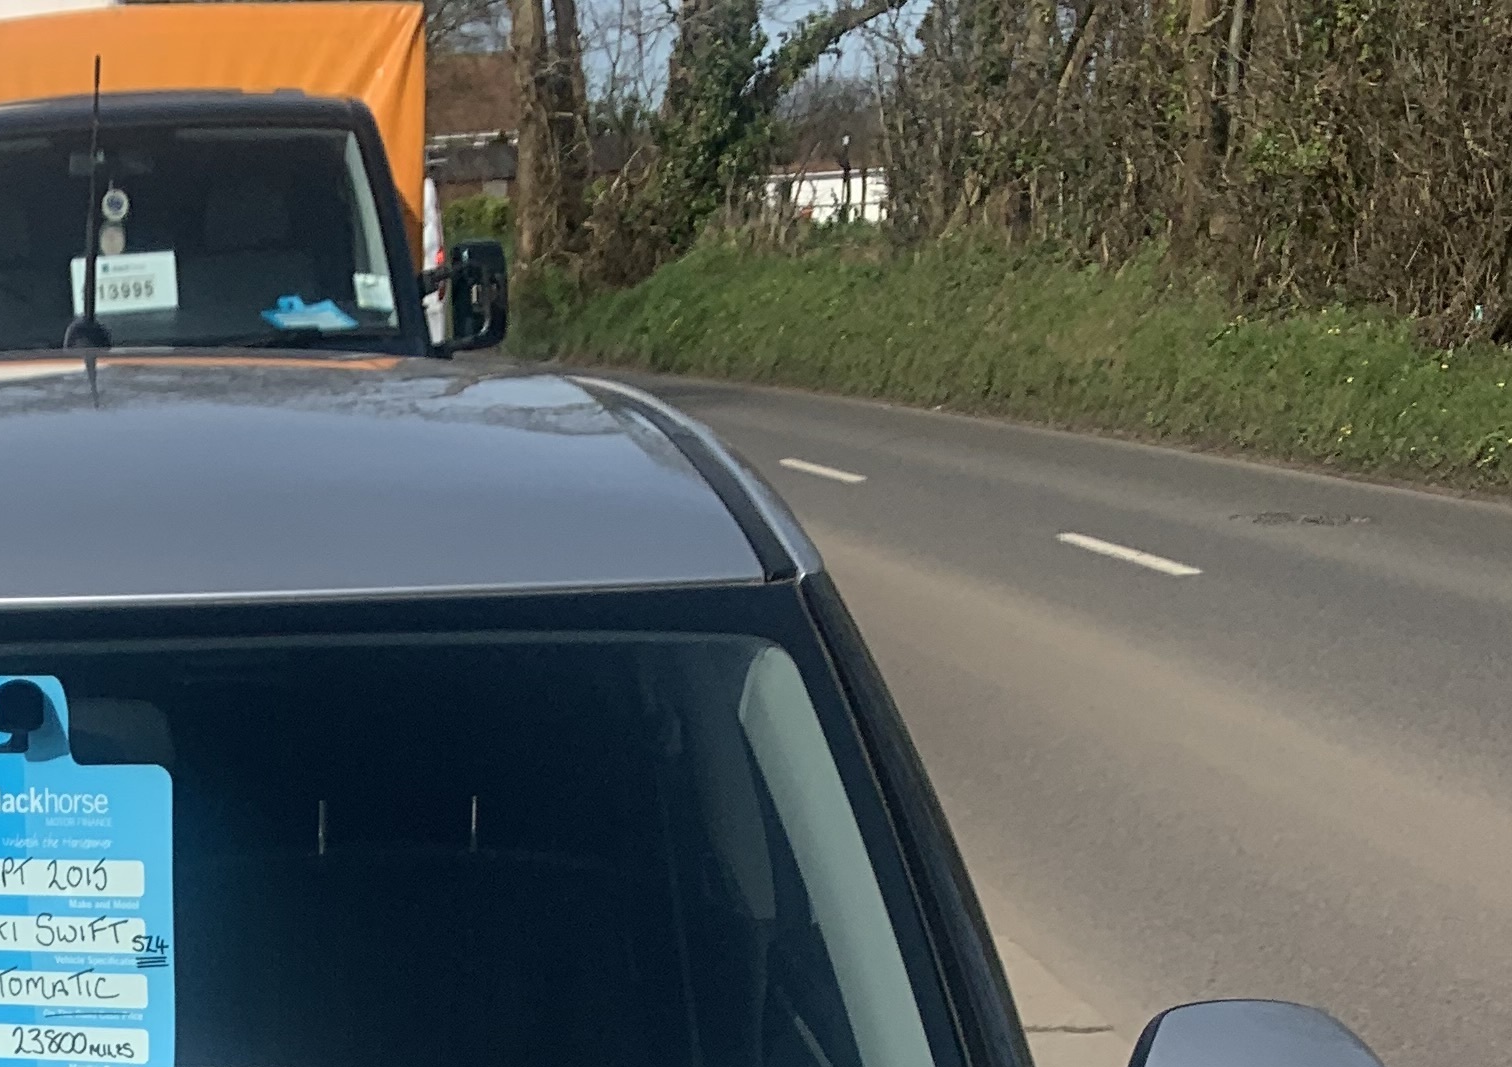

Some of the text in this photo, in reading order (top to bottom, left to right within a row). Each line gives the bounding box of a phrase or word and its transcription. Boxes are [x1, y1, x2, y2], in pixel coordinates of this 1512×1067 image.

[47, 857, 108, 891] 2015
[35, 913, 129, 947] SWIFT
[131, 934, 169, 955] SZ4
